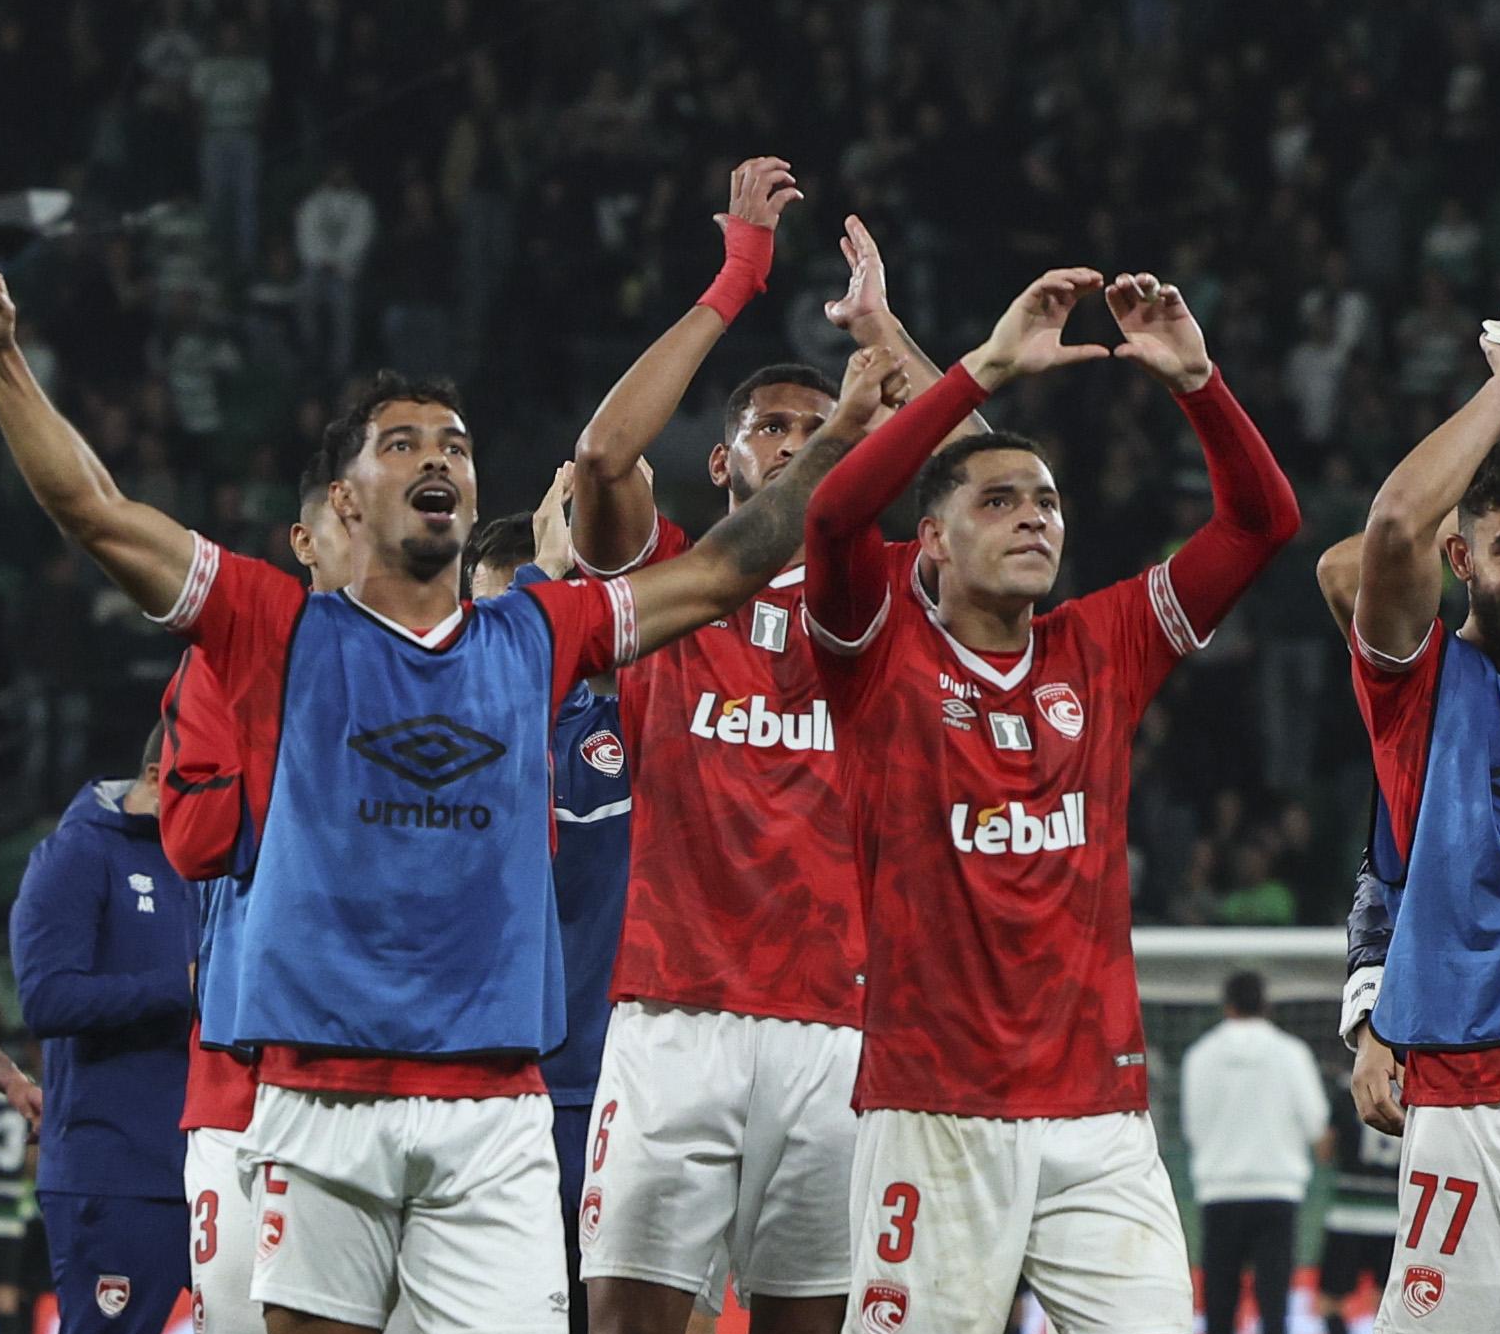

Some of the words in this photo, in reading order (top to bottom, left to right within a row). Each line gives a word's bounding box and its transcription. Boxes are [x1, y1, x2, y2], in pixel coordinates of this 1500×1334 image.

[358, 796, 493, 831] umbro
[876, 1181, 921, 1264] 3
[1405, 1170, 1479, 1256] 77
